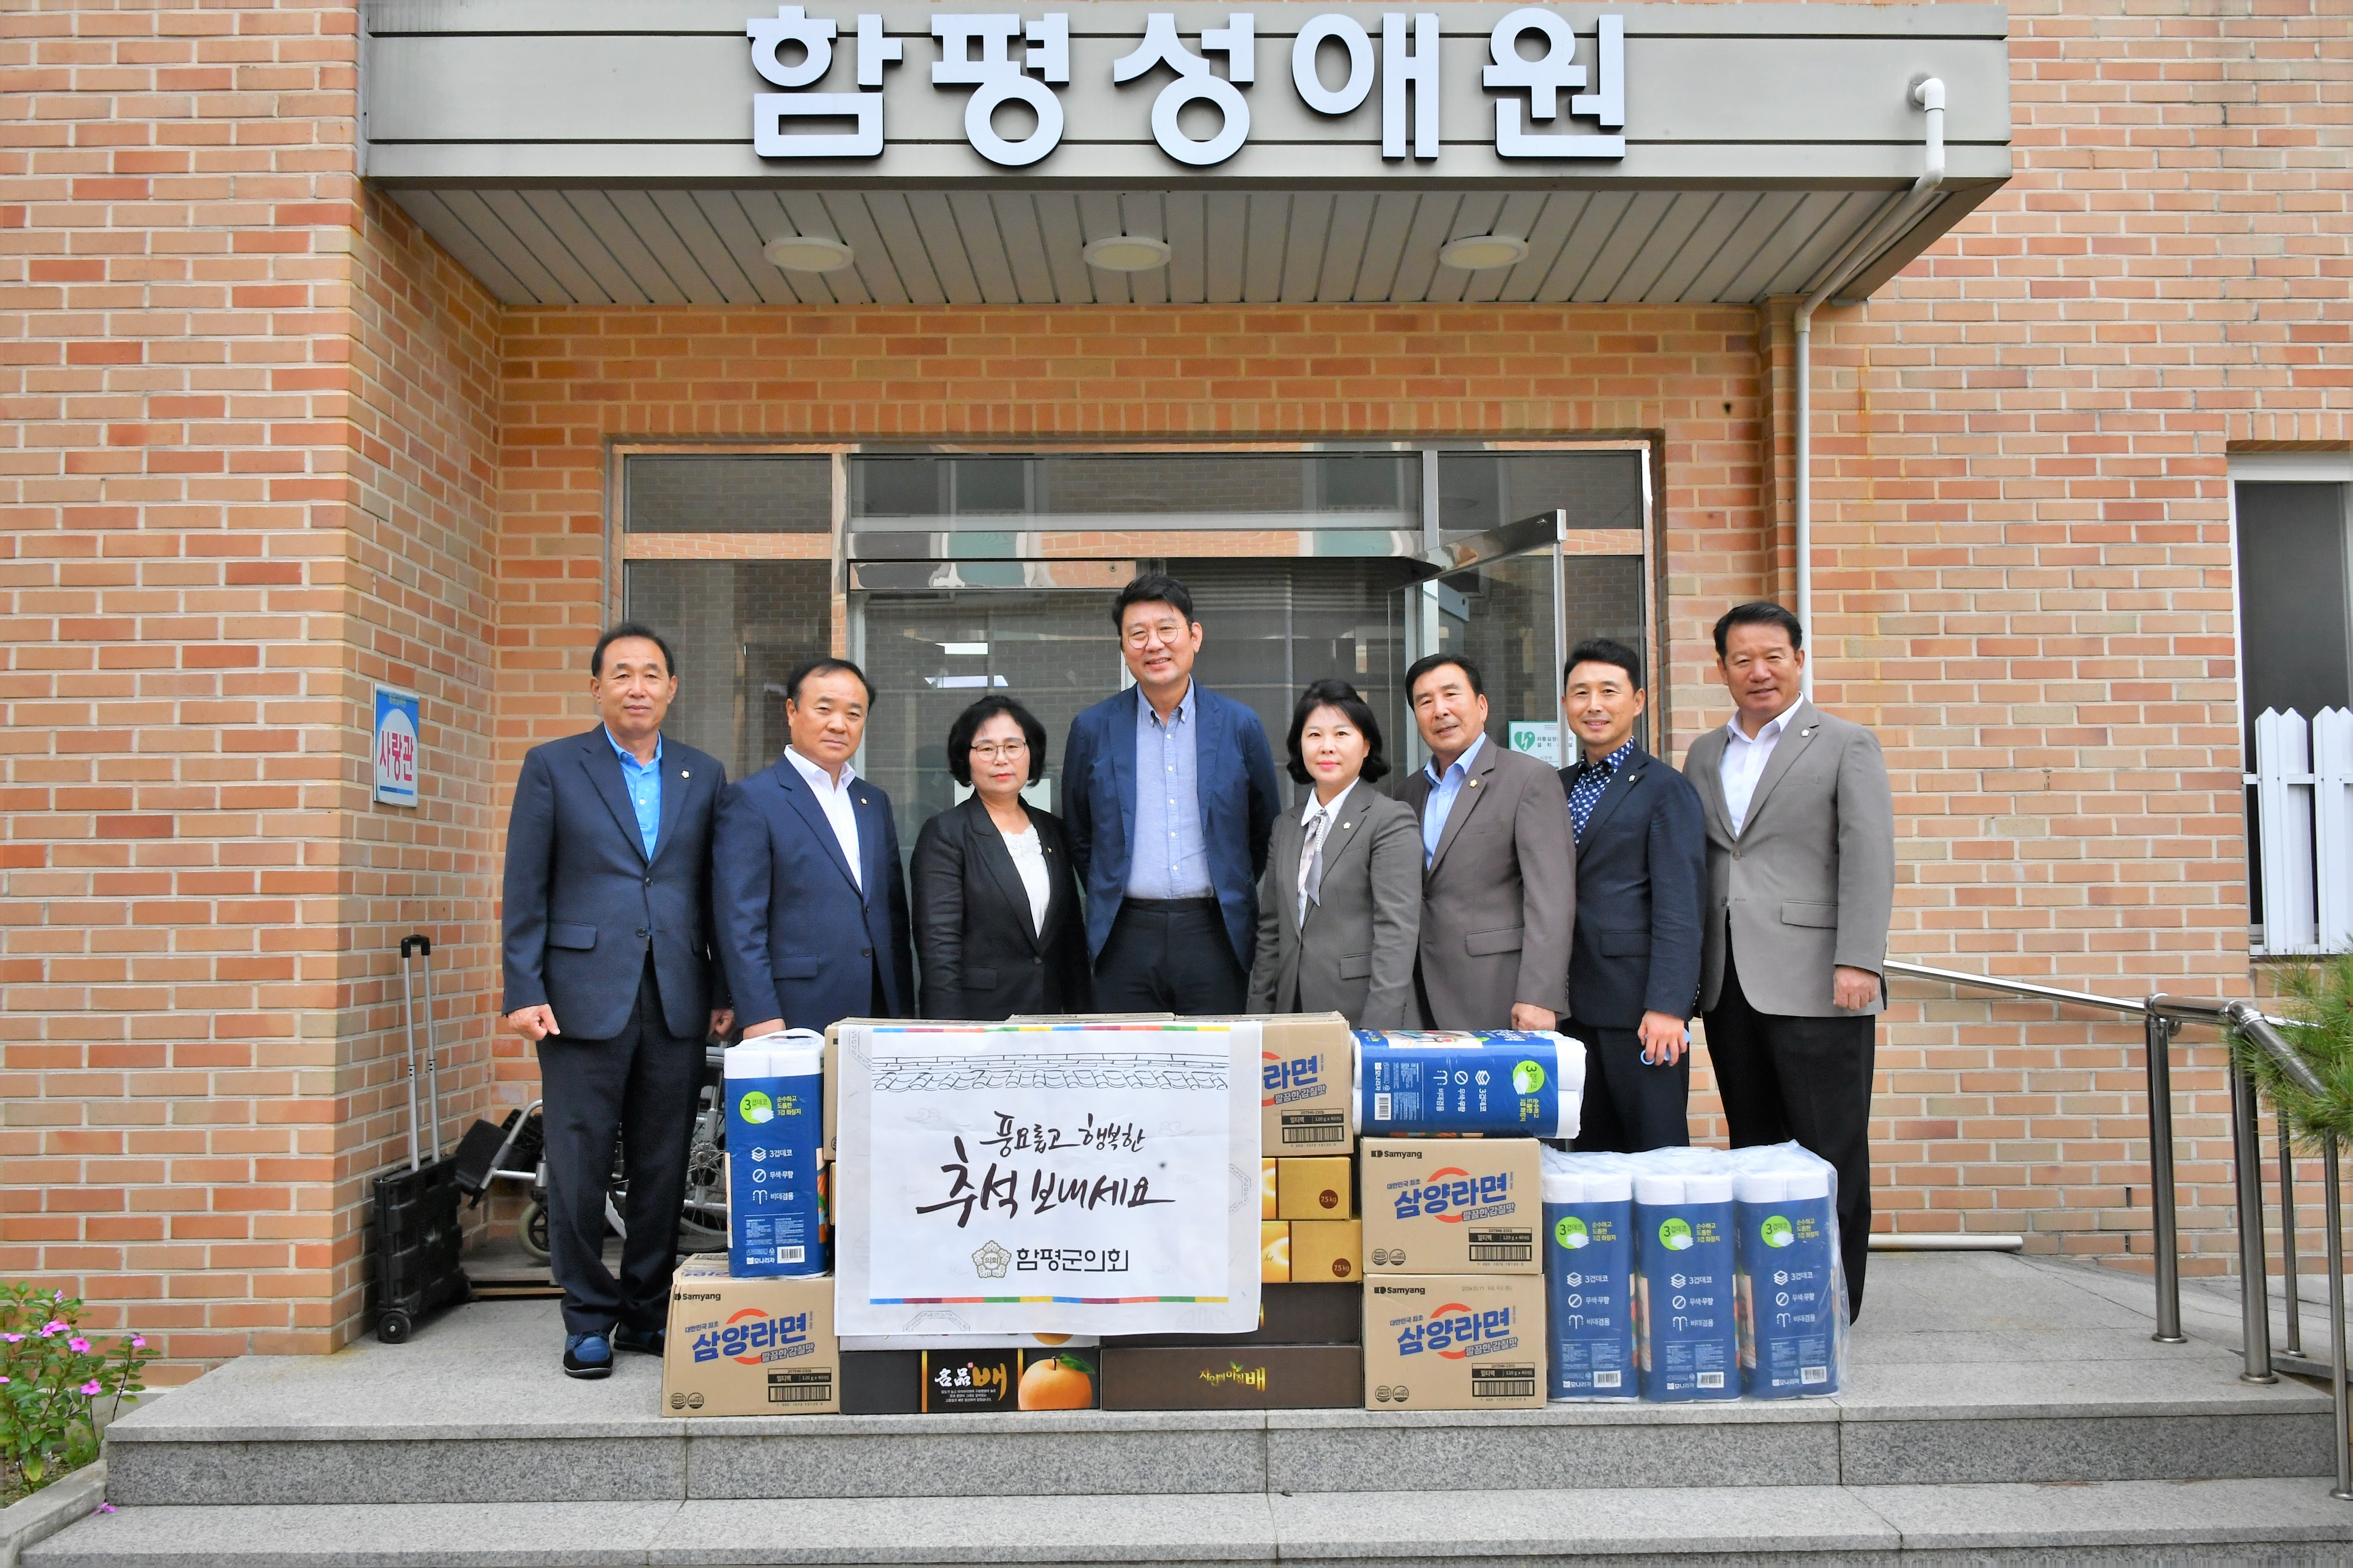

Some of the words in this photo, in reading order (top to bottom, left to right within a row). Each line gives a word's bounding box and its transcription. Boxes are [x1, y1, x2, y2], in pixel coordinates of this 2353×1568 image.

[746, 5, 1626, 166] 함평성애원
[1263, 1055, 1318, 1089] 라면
[1275, 1089, 1301, 1105] 깔끔한
[1301, 1084, 1327, 1099] 감칠맛
[980, 1110, 1081, 1158] 풍요롭고
[1078, 1113, 1145, 1153] 행복한
[769, 1149, 793, 1158] 3겹데코
[1384, 1151, 1422, 1159] Samyang
[916, 1136, 1018, 1228] 추석
[1032, 1170, 1176, 1215] 보내세요
[1387, 1181, 1409, 1189] 대한민국
[1394, 1173, 1507, 1219] 삼양라면
[1462, 1208, 1488, 1222] 깔끔한
[1488, 1202, 1515, 1217] 감칠맛
[1016, 1248, 1128, 1272] 함평군의회
[685, 1323, 707, 1333] 대한민국
[1390, 1316, 1411, 1326] 대한민국
[1397, 1307, 1509, 1356] 삼양라면
[692, 1312, 806, 1363] 삼양라면
[1466, 1344, 1492, 1357] 깔끔한
[1492, 1337, 1518, 1353] 감칠맛
[761, 1349, 787, 1363] 깔끔한
[787, 1342, 815, 1358] 감칠맛
[1244, 1366, 1266, 1392] 배
